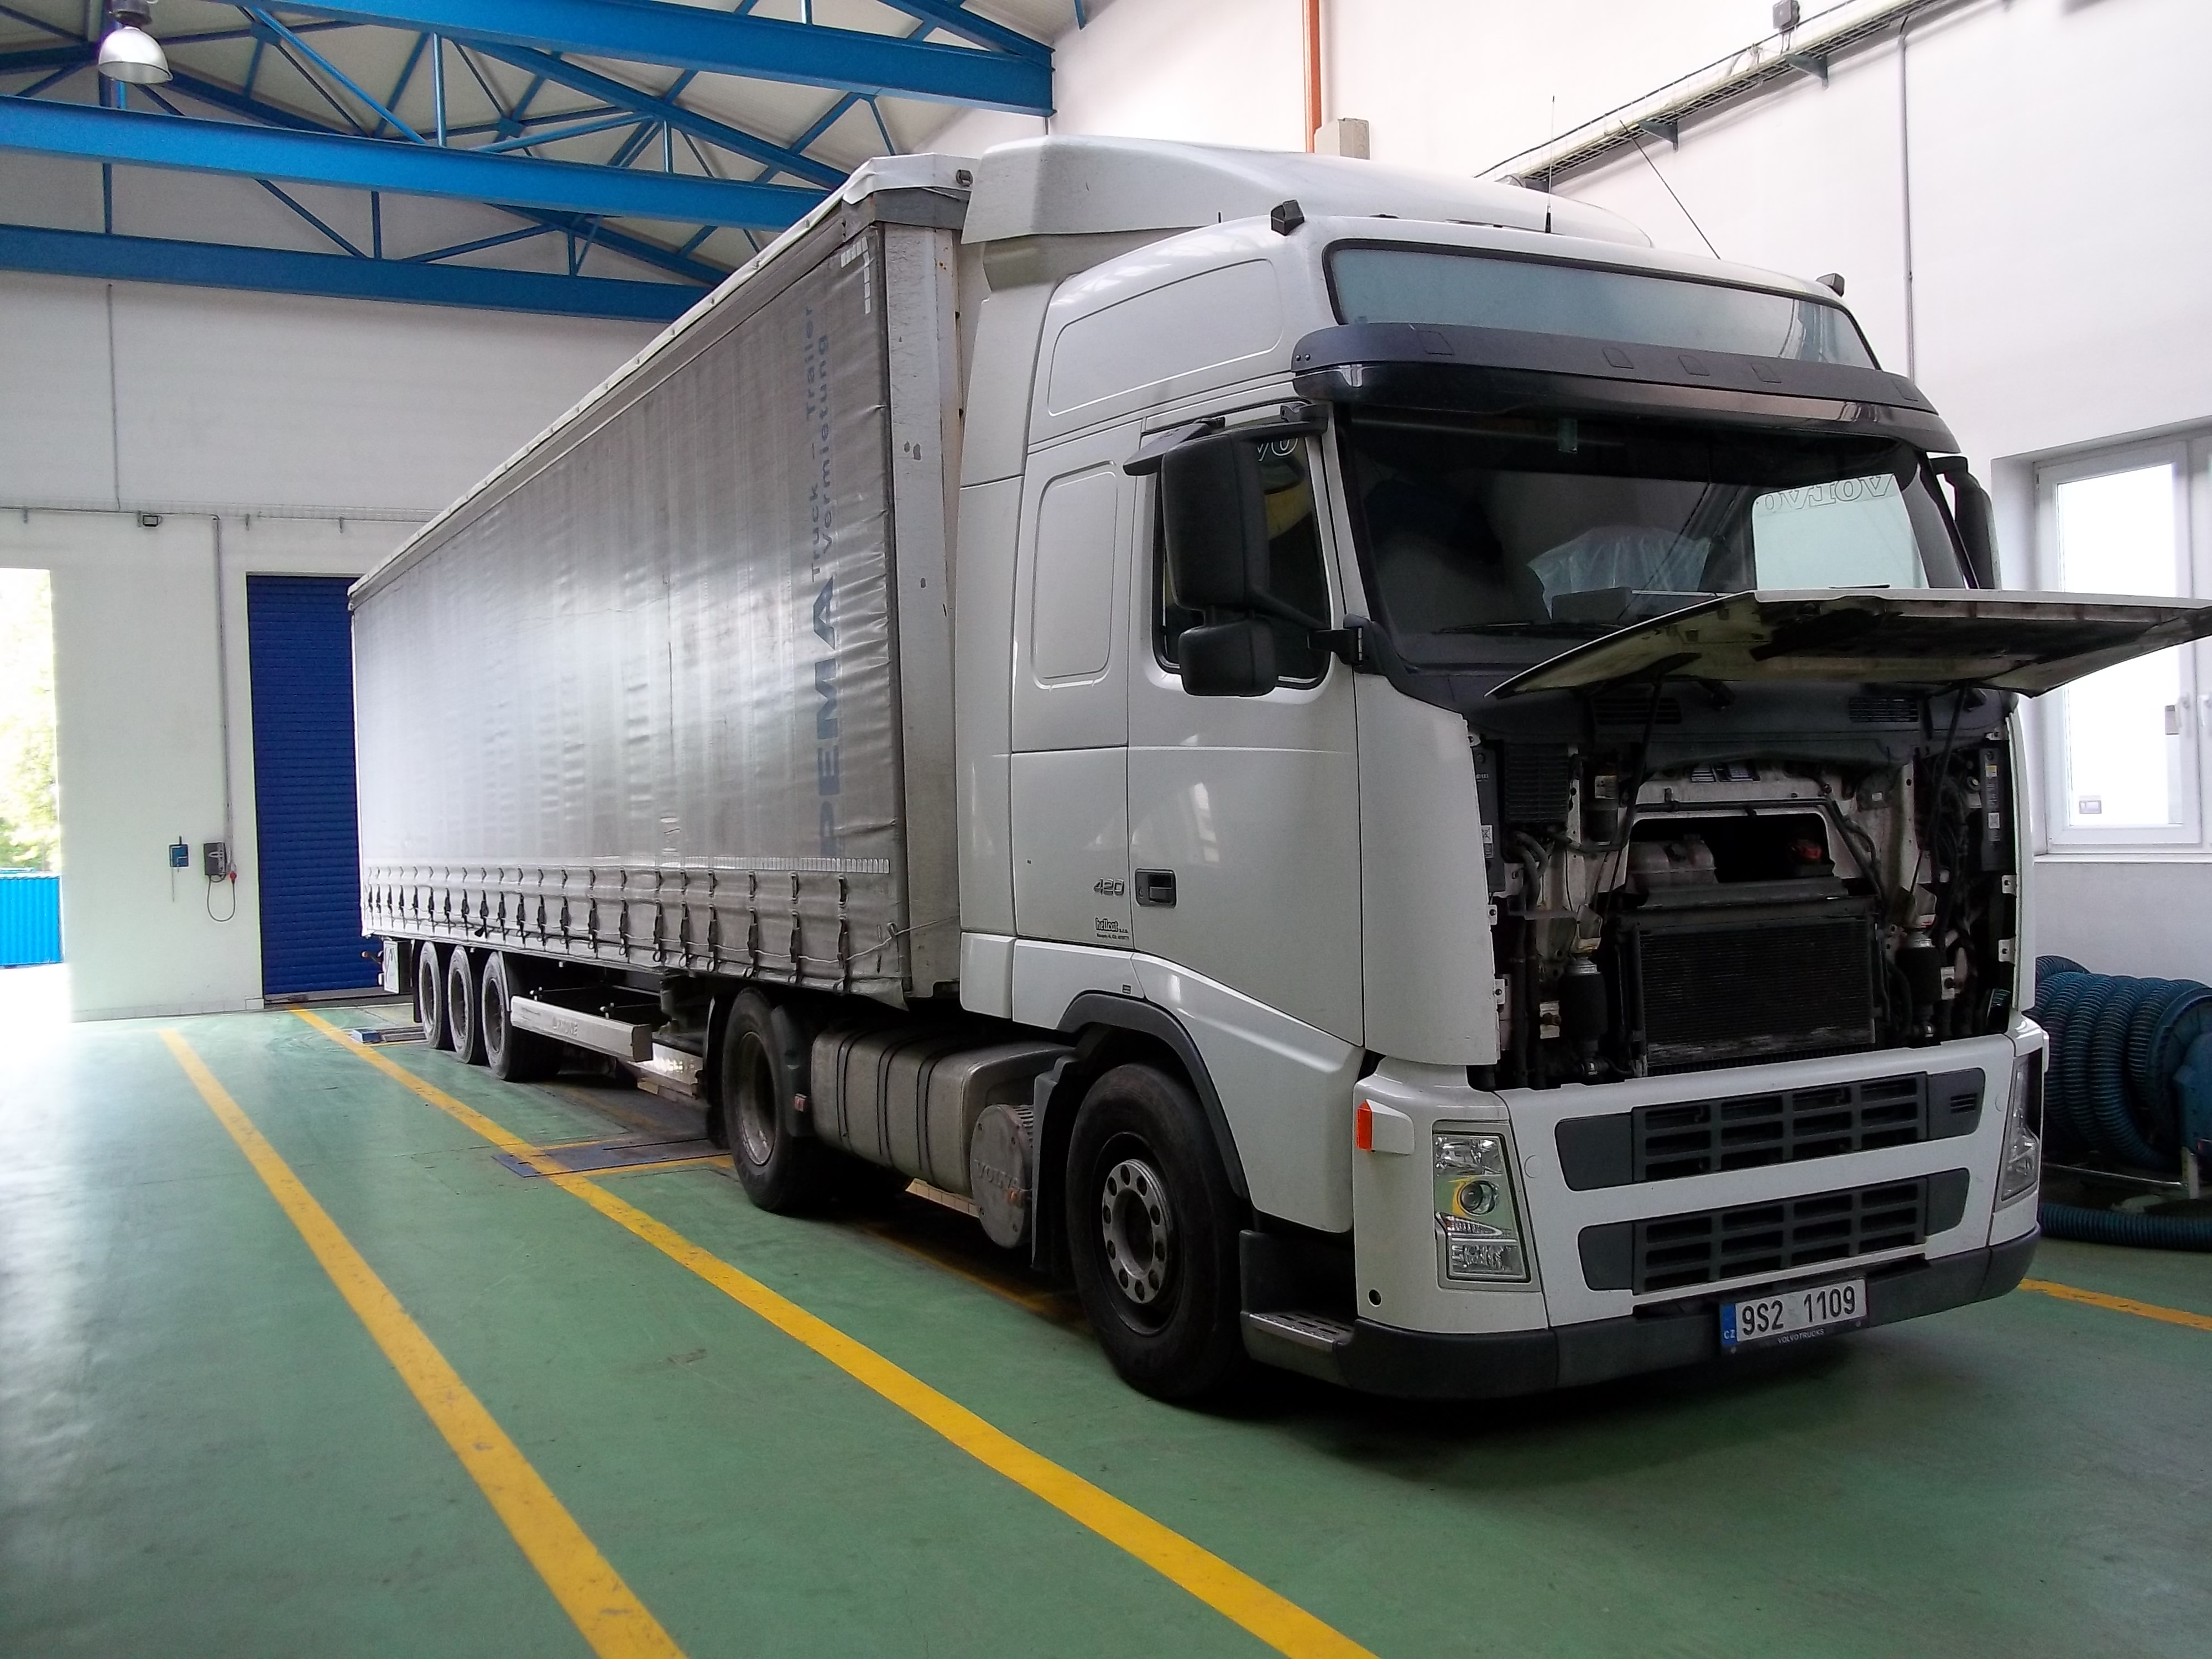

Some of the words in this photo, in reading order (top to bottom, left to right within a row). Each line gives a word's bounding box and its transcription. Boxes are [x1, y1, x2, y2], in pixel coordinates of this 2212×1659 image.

[805, 307, 816, 421] Trailer
[818, 334, 833, 555] Vermietung
[809, 483, 822, 582] Truck
[812, 576, 842, 857] PEMA
[1093, 877, 1125, 896] 420
[1095, 917, 1119, 932] hellcat
[1723, 1329, 1735, 1339] CZ
[1741, 1300, 1785, 1336] 9S2
[1803, 1285, 1856, 1323] 1109
